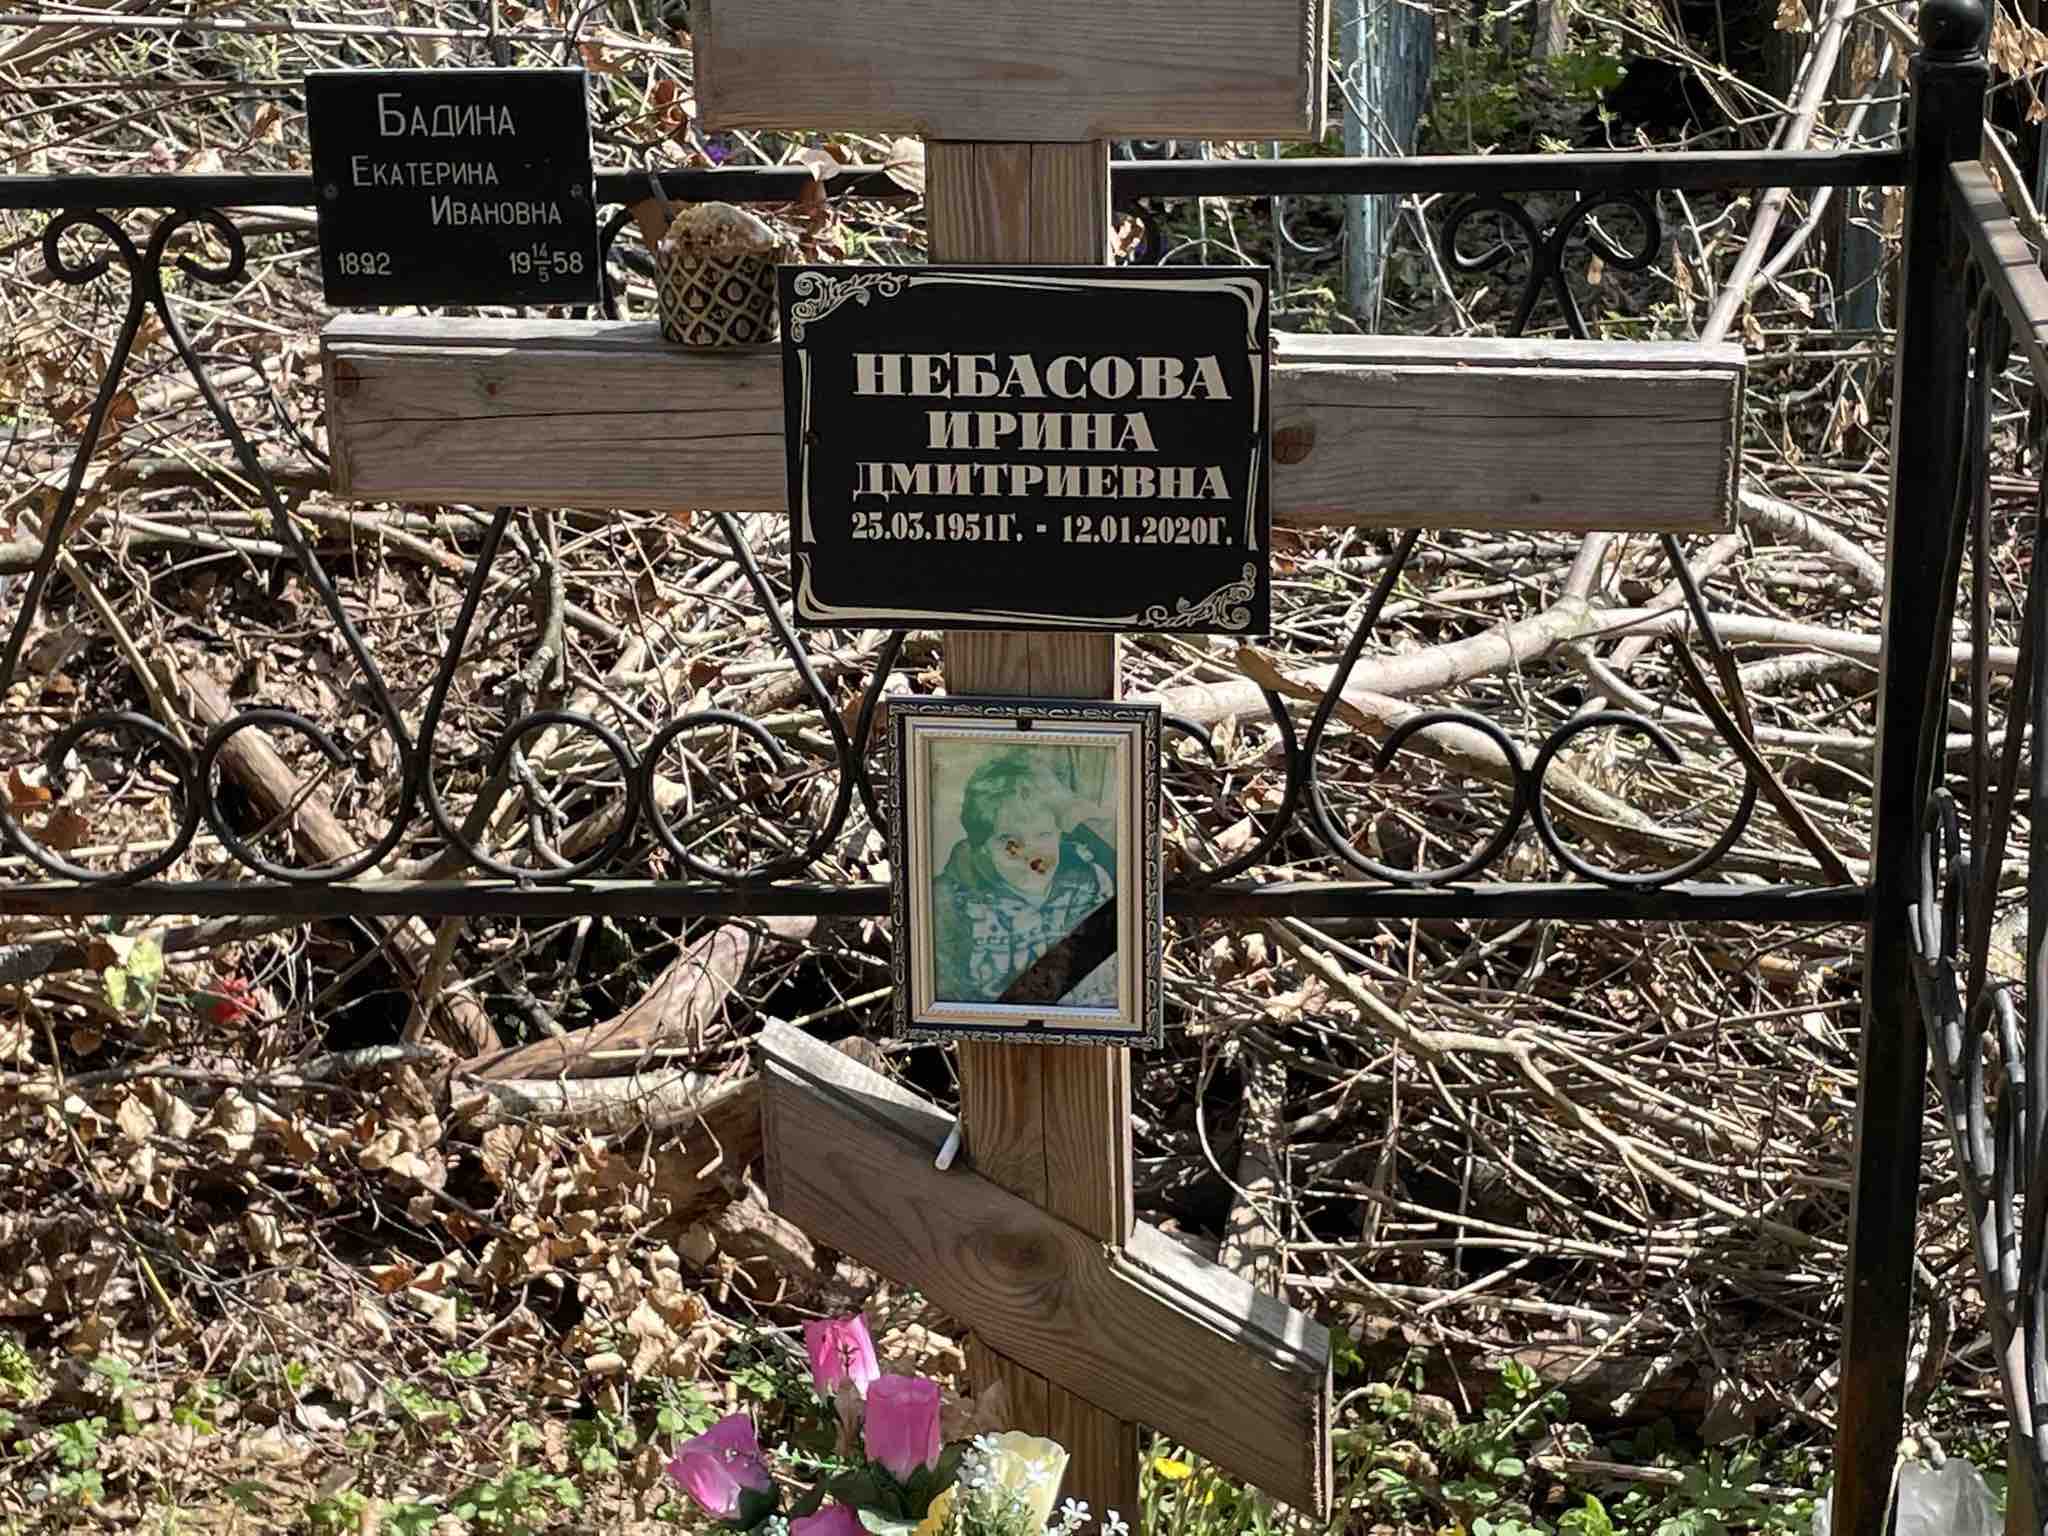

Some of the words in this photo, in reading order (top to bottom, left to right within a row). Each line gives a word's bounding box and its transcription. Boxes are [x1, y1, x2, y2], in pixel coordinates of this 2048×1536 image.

[852, 351, 1233, 400] НЕБАСОВА
[924, 410, 1159, 452] ИРИНА
[852, 462, 1232, 503] ДМИТРИЕВНА
